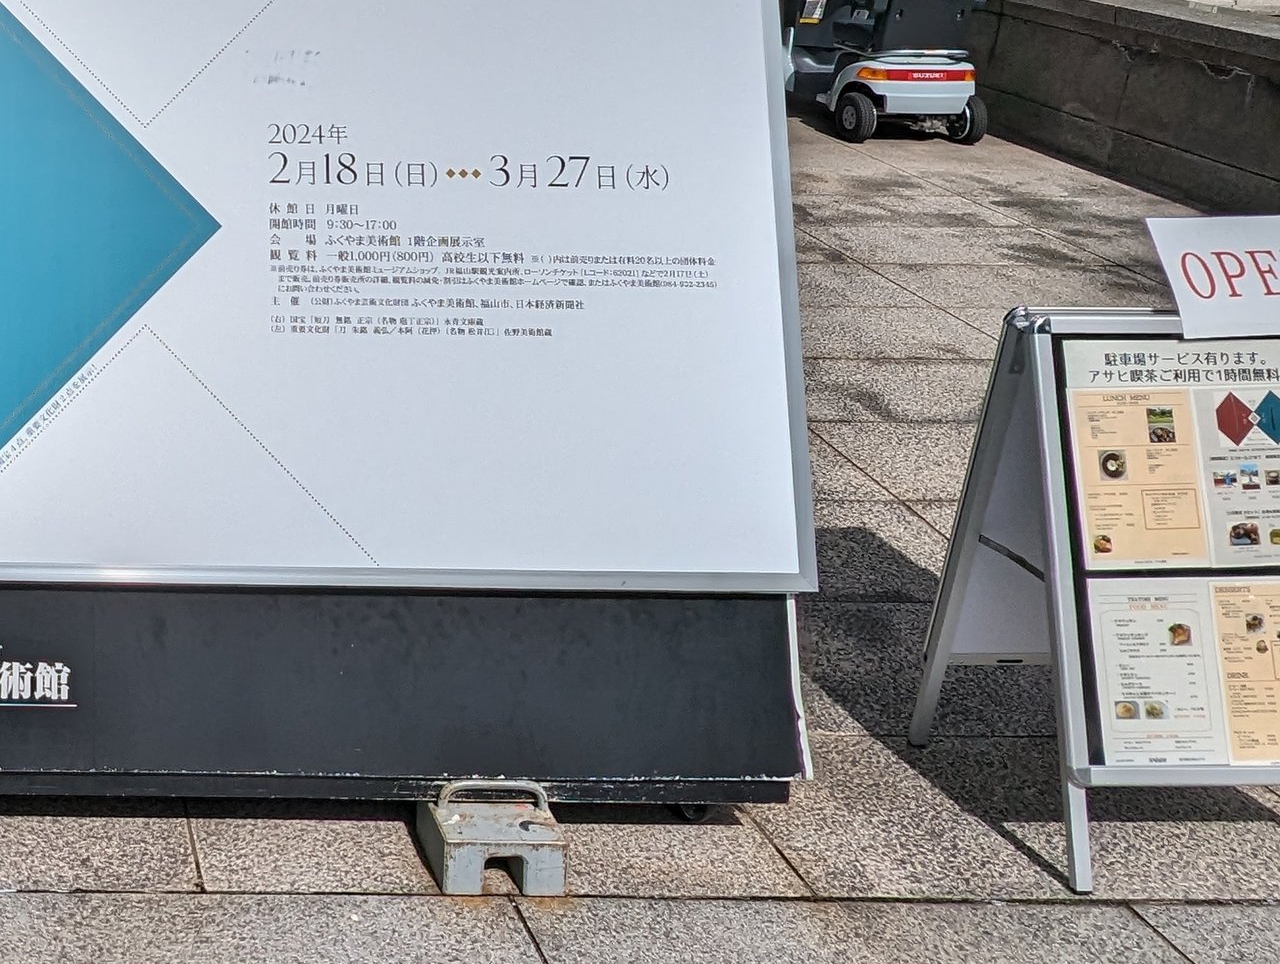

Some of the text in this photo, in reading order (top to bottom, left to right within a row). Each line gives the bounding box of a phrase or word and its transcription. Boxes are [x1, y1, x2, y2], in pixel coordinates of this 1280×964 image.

[912, 71, 944, 79] SUZUKI
[267, 123, 348, 145] 2024年
[268, 151, 669, 191] 2月18日(日) 3月27日(水)
[269, 202, 359, 216] 休館日 月曜日
[269, 218, 317, 231] 開館時間
[325, 235, 401, 247] ふくやま美術館
[408, 235, 486, 248] 1階企画展示室
[269, 249, 318, 262] 観覧料
[441, 251, 525, 265] 高校生以下無料
[1180, 248, 1280, 299] OPE
[1104, 351, 1267, 367] 駐車場サービス有ります。
[1088, 368, 1280, 383] アサヒ喫茶ご利用で1時間無料
